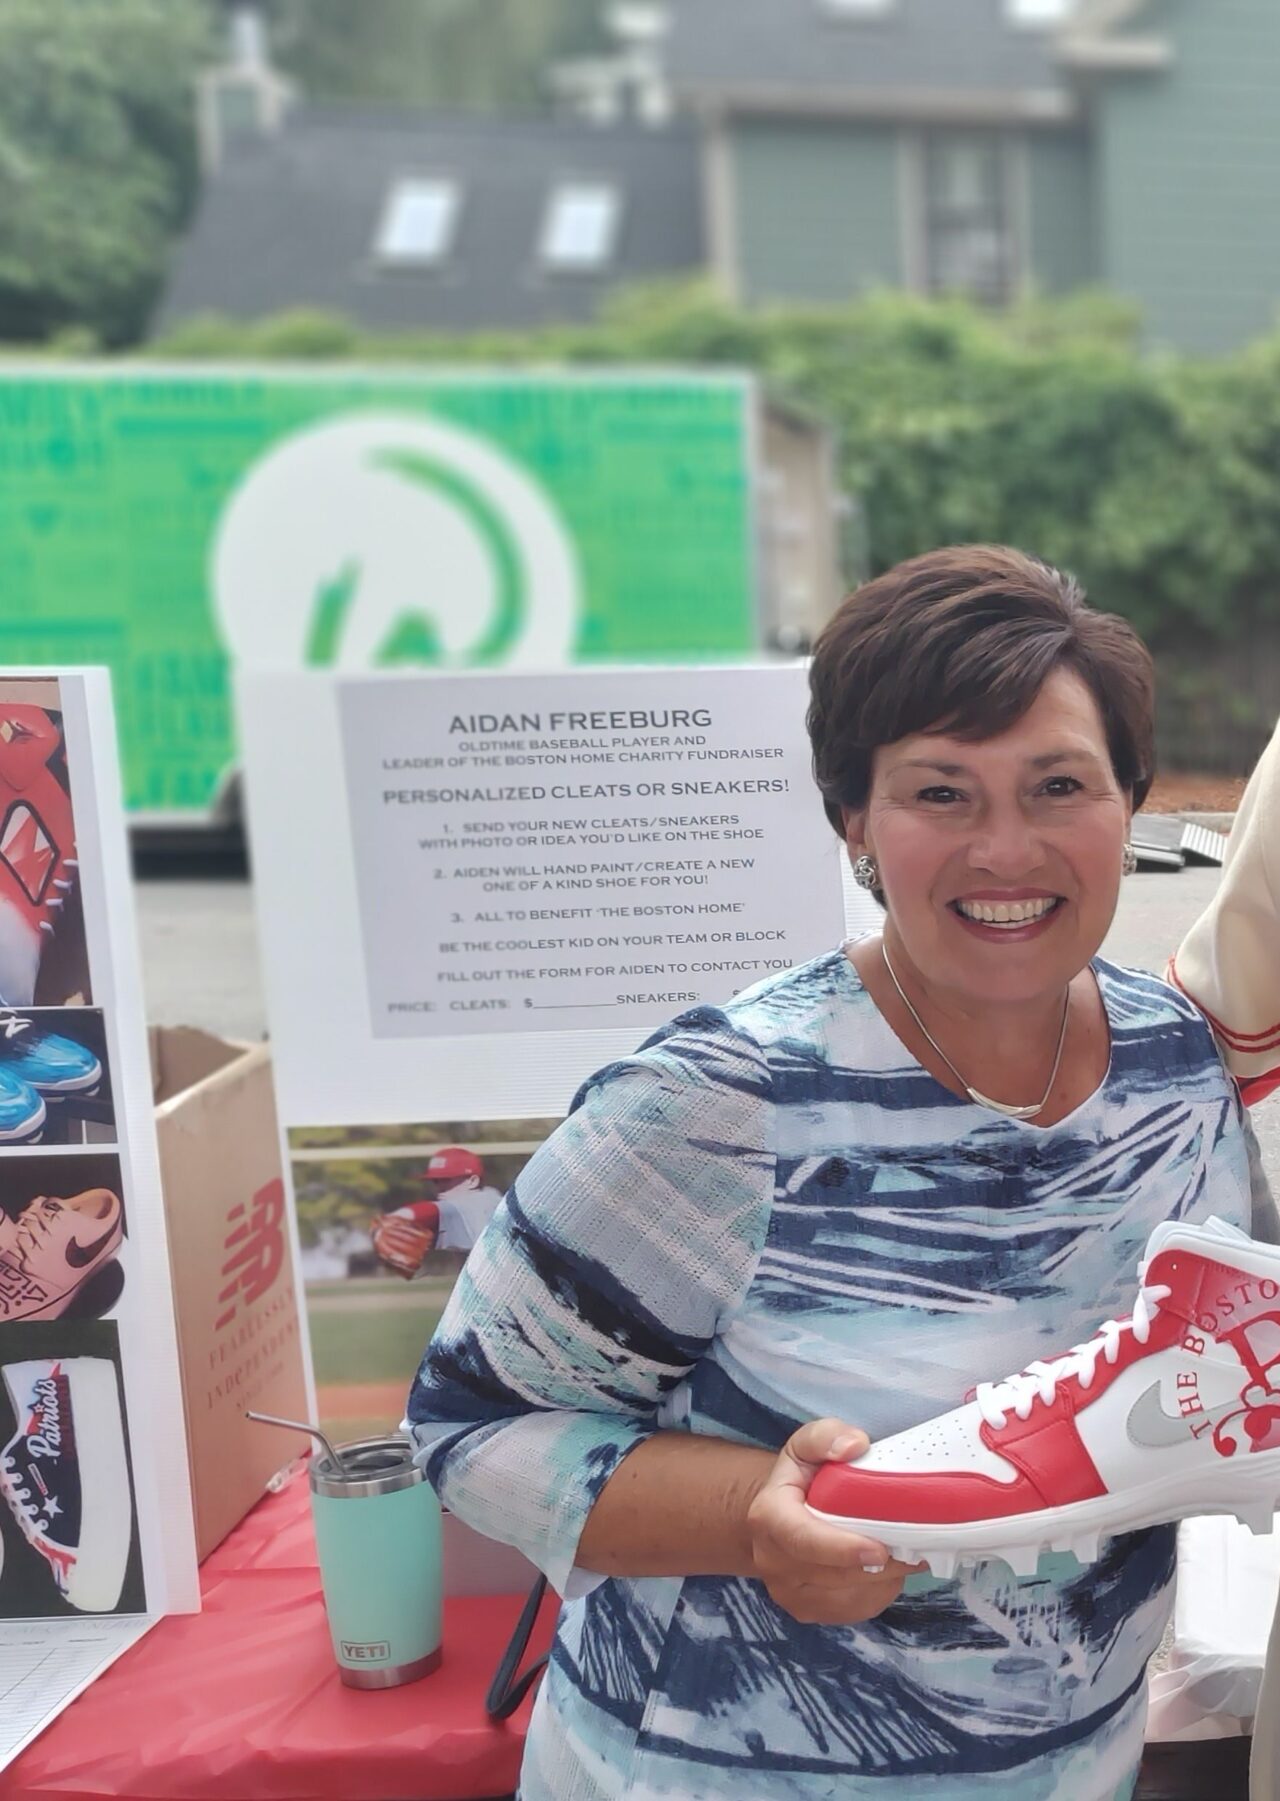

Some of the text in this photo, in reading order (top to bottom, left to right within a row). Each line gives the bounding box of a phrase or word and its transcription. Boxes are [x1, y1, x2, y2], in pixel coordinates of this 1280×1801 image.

[449, 709, 712, 734] AIDAN FREEBURG
[458, 735, 706, 752] OLDTIME BASEBALL PLAYER AND
[382, 748, 784, 768] LEADER OF THE BOSTON HOME CHARITY FUNDRAISER
[382, 779, 790, 804] PERSONALIZED CLEATS OR SNEAKERS!
[463, 822, 504, 833] SEND
[508, 821, 548, 832] YOUR
[552, 819, 587, 830] NEW
[592, 815, 740, 829] CLEATS/SNEAKERS
[418, 829, 764, 849] WITH PHOTO OR IDEA YOU'D LIKE ON THE SHOE
[453, 866, 500, 878] AIDEN
[502, 865, 540, 876] WILL
[544, 864, 587, 875] HAND
[591, 860, 702, 874] PAINT/CREATE
[706, 860, 716, 870] A
[721, 859, 755, 870] NEW
[482, 875, 708, 892] ONE OF A KIND SHOE FOR YOU!
[440, 930, 786, 952] BE THE COOLEST KID ON YOUR TEAM OR BLOCK
[436, 959, 792, 982] FILL OUT THE FORM FOR AIDEN TO CONTACT YOU
[1177, 1371, 1212, 1440] THE
[26, 1378, 62, 1458] Patriots
[344, 1644, 385, 1659] YETI
